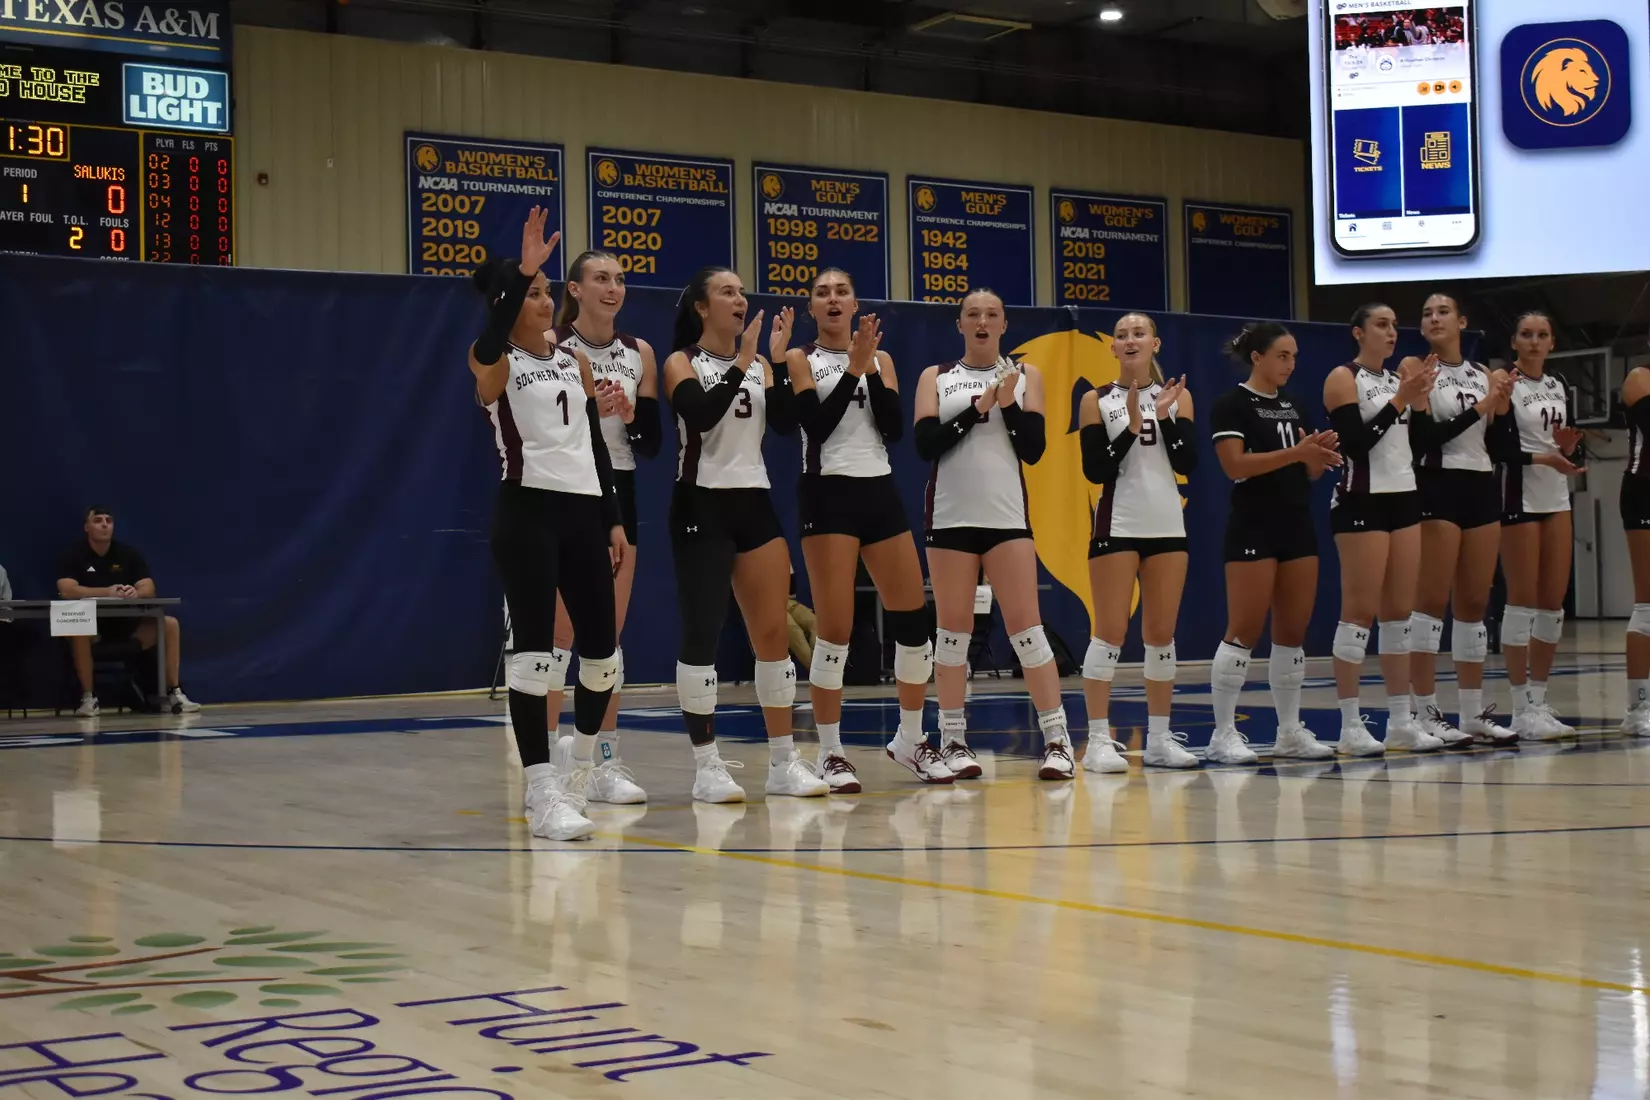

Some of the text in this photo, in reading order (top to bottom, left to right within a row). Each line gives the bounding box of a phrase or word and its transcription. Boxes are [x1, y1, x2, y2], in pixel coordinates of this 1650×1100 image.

[133, 5, 220, 40] A&M
[30, 66, 56, 82] TO
[64, 69, 100, 87] THE
[142, 71, 209, 99] BUD
[19, 80, 86, 104] HOUSE
[130, 94, 222, 125] LIGHT
[9, 125, 64, 156] 1:30
[156, 138, 218, 152] PLYR FLS PTS
[148, 153, 227, 175] 02 0 0
[457, 150, 546, 169] WOMEN'S
[3, 167, 38, 179] PERIOD
[73, 164, 125, 181] SALUKIS
[444, 160, 558, 181] BASKETBALL
[634, 163, 717, 181] WOMEN'S
[149, 172, 228, 193] 03 0 0
[418, 176, 553, 196] NCAA TOURNAMENT
[623, 173, 728, 193] BASKETBALL
[811, 179, 860, 194] MEN'S
[23, 184, 28, 203] 1
[108, 185, 125, 214] 0
[149, 193, 228, 213] 04 0 0
[422, 192, 486, 214] 2007
[597, 190, 726, 207] CONFERENCE CHAMPIONSHIPS
[815, 191, 856, 204] GOLF
[961, 191, 1007, 205] MEN'S
[0, 210, 130, 228] AYER FOUL T.O.L. FOULS
[602, 205, 662, 227] 2007
[764, 202, 879, 221] NCAA TOURNAMENT
[965, 203, 1002, 215] GOLF
[1088, 204, 1154, 219] WOMEN'S
[155, 212, 228, 232] 12 0 0
[422, 217, 480, 239] 2019
[767, 218, 879, 242] 1998 2022
[916, 215, 1027, 230] CONFERENCE CHAMPIONSHIPS
[1104, 215, 1140, 227] GOLF
[69, 226, 84, 249] 2
[111, 229, 125, 252] 0
[155, 233, 228, 252] 13 0 0
[603, 229, 662, 251] 2020
[920, 229, 967, 249] 1942
[1060, 226, 1159, 242] NCAA TOURNAMENT
[422, 242, 487, 264] 2020
[768, 240, 819, 261] 1999
[1062, 240, 1105, 259] 2019
[617, 254, 656, 274] 021
[921, 251, 969, 271] 1964
[1063, 261, 1105, 279] 2021
[768, 263, 818, 283] 2001
[922, 273, 969, 292] 1965
[1064, 282, 1110, 301] 2022
[515, 369, 559, 390] SOUTHERN
[815, 364, 846, 382] SOUTHE
[944, 381, 983, 397] SOUTHERN
[556, 390, 570, 425] 1
[735, 388, 753, 419] 3
[1540, 407, 1563, 431] 14
[1139, 418, 1157, 446] 9
[1277, 421, 1296, 449] 11
[393, 985, 775, 1082] Hunt
